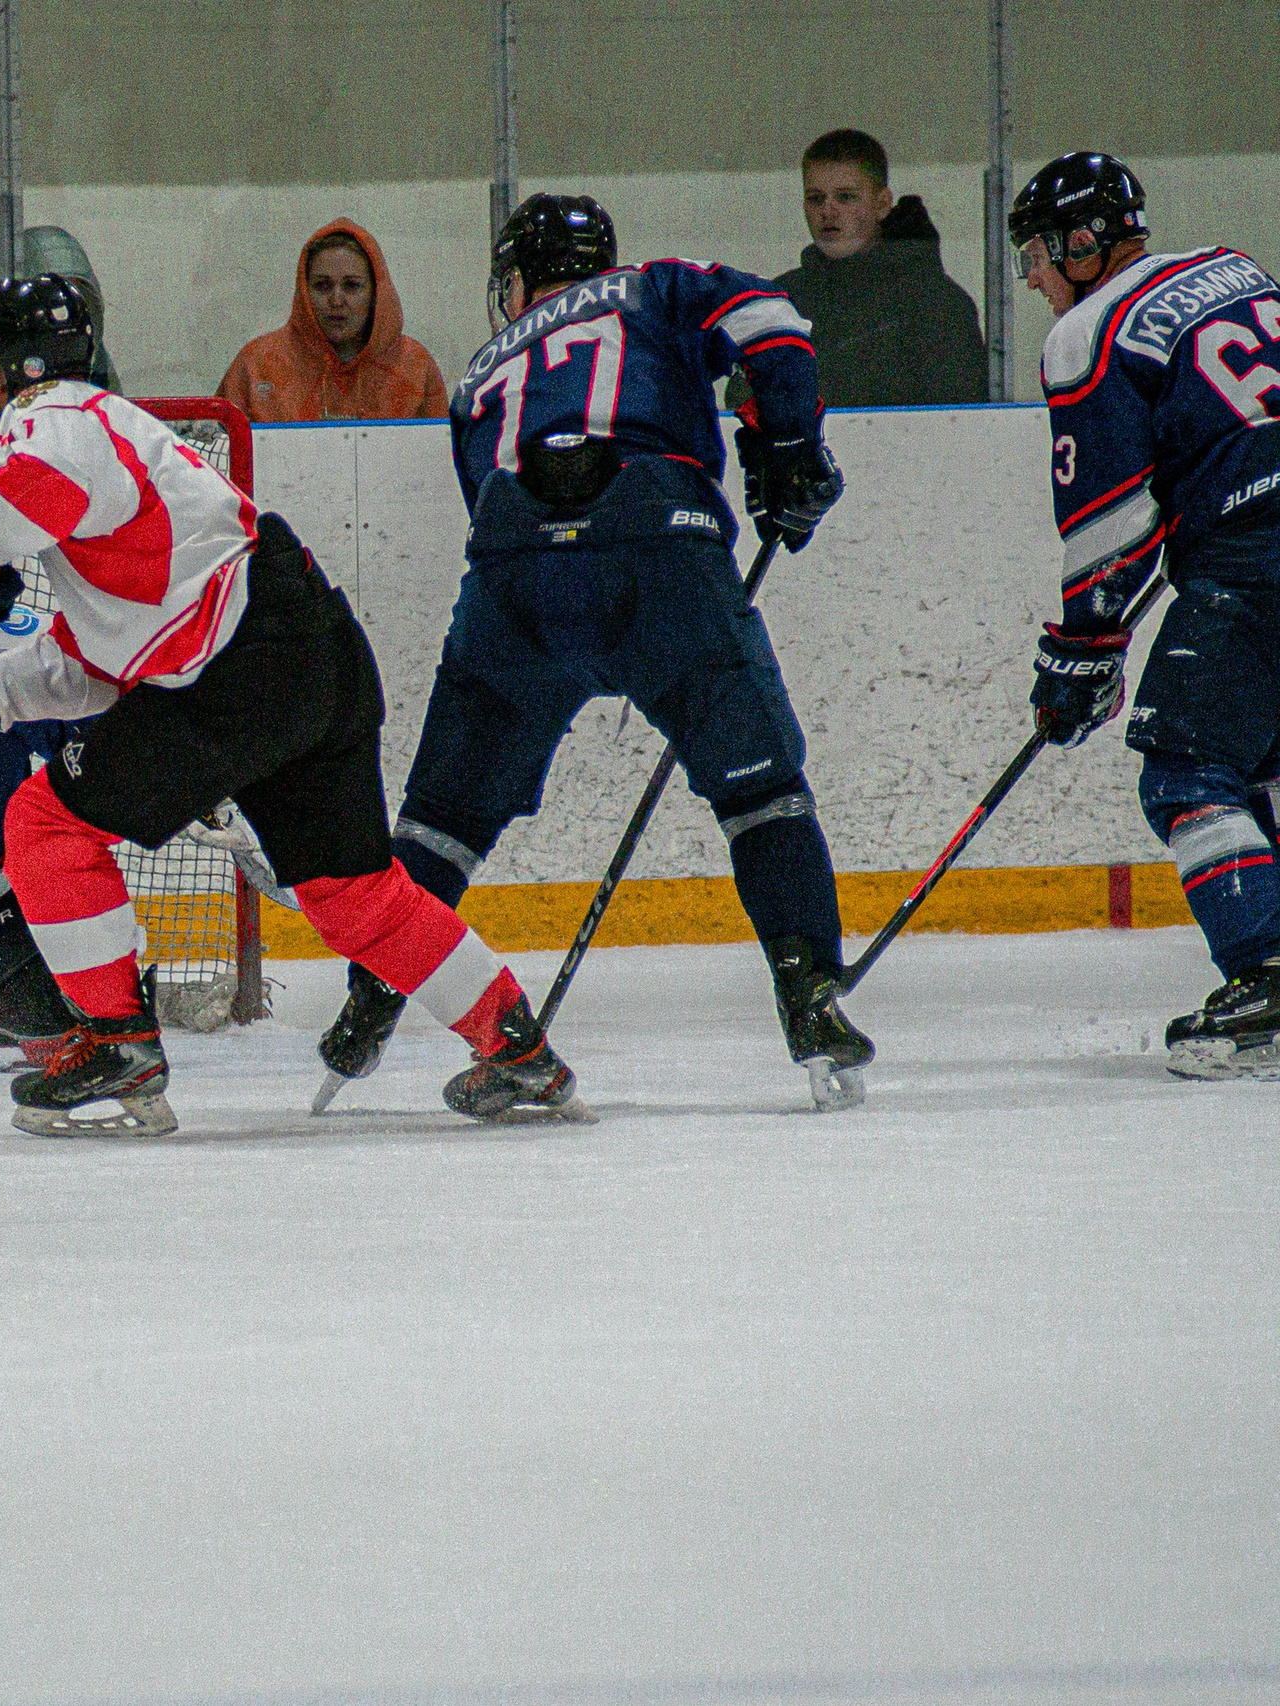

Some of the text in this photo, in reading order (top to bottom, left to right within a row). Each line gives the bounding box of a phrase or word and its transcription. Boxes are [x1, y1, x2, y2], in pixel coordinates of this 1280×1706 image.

[1056, 186, 1096, 207] BAUER
[1137, 261, 1268, 347] КУЗЬМИН
[459, 277, 627, 396] КОШМАН
[470, 311, 627, 475] 77
[671, 510, 720, 533] BAU
[1037, 651, 1114, 676] AUER
[726, 759, 772, 779] BAUER
